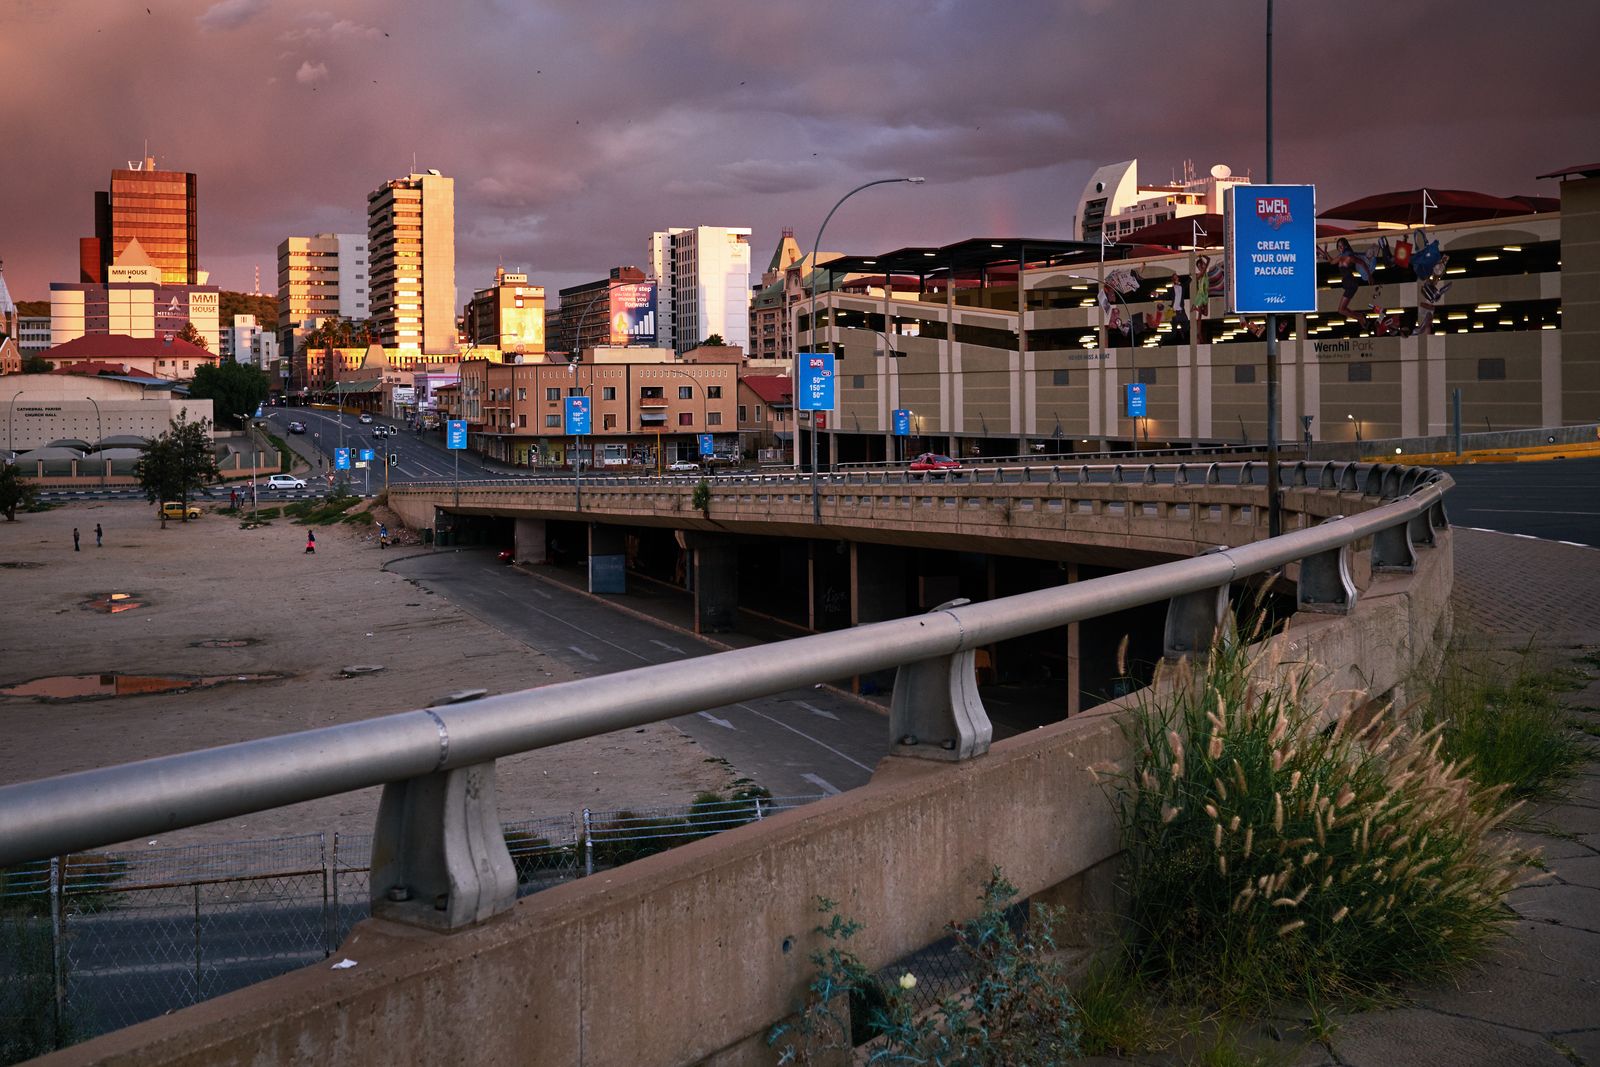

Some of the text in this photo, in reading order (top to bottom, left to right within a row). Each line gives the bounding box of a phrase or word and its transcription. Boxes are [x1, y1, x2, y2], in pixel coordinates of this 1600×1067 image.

[1257, 241, 1290, 250] CREATE
[1251, 253, 1296, 263] YOUR OWN
[1254, 266, 1294, 275] PACKAGE
[191, 294, 217, 303] MMI
[1314, 340, 1374, 352] Wernhil Park
